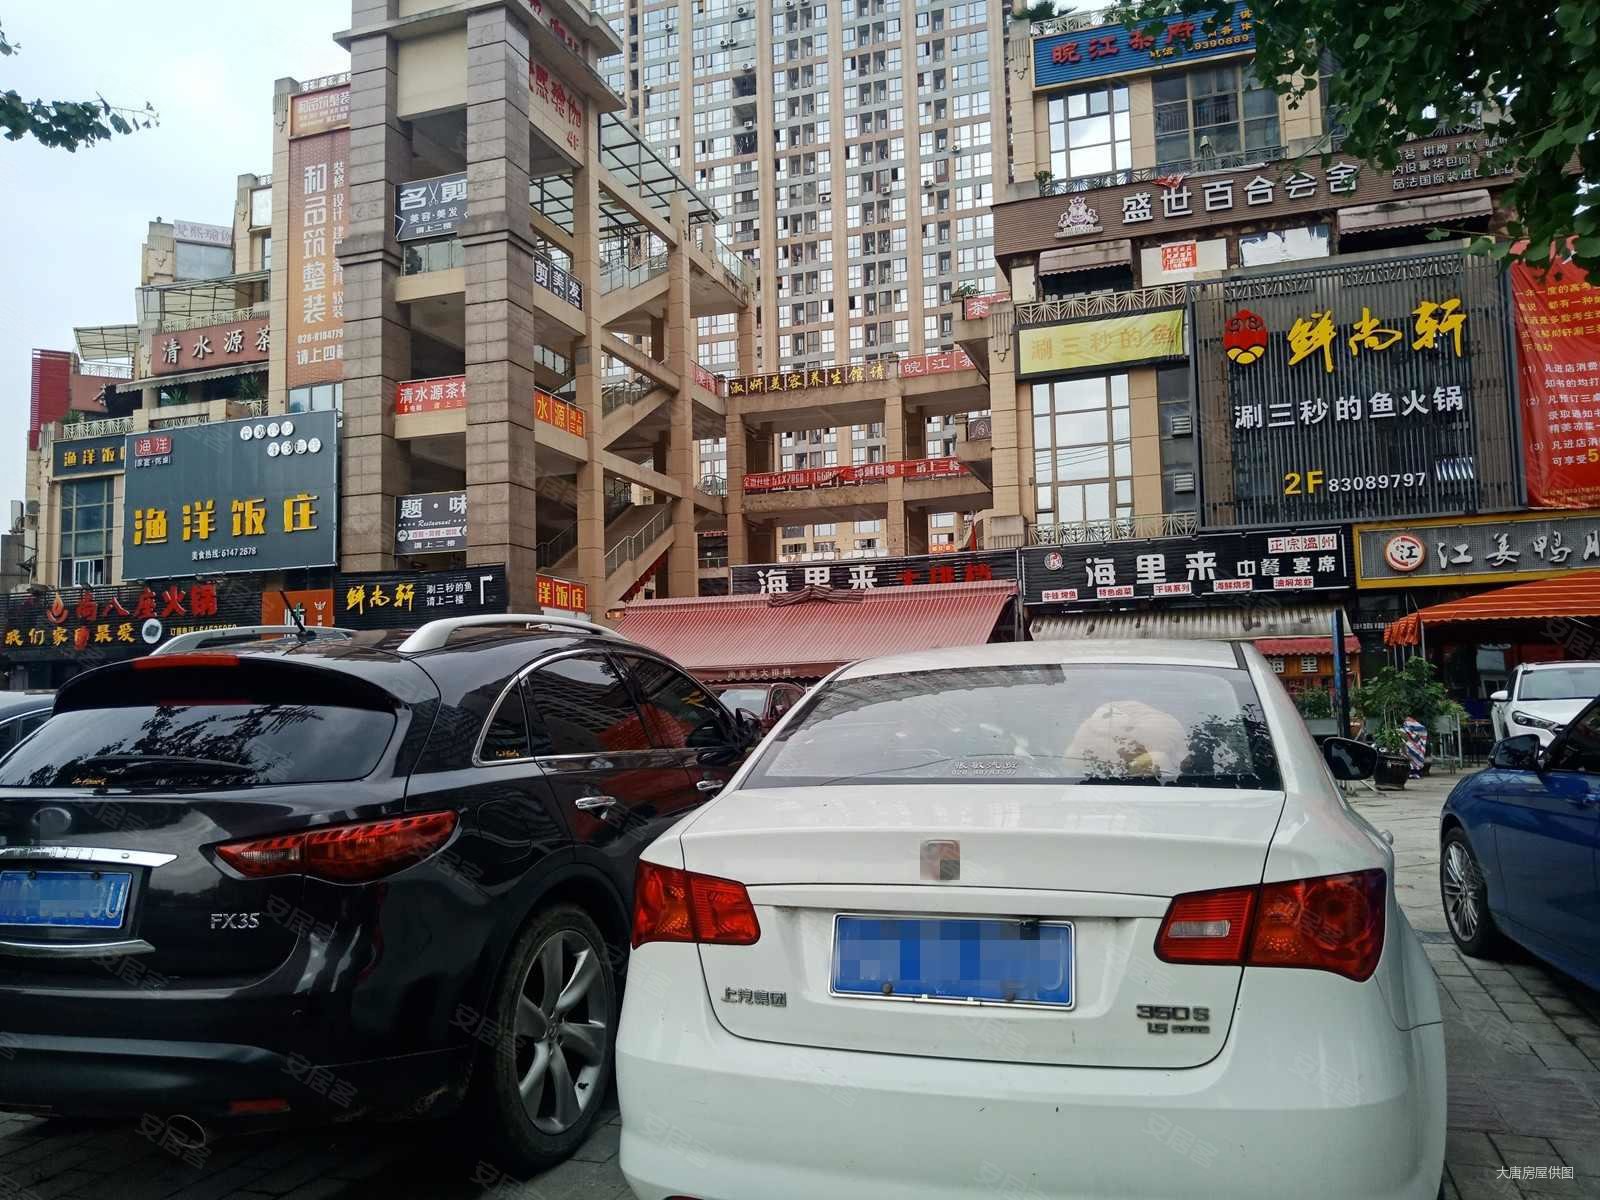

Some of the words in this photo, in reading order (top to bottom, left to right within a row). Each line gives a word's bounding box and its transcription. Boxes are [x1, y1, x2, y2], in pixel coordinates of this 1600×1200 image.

[1234, 385, 1464, 430] 涮三秒的鱼火锅
[1284, 470, 1325, 495] 2F
[1328, 472, 1427, 492] 83089797
[133, 493, 320, 546] 渔洋饭庄
[1085, 551, 1218, 588] 海里来
[210, 912, 261, 929] FX35
